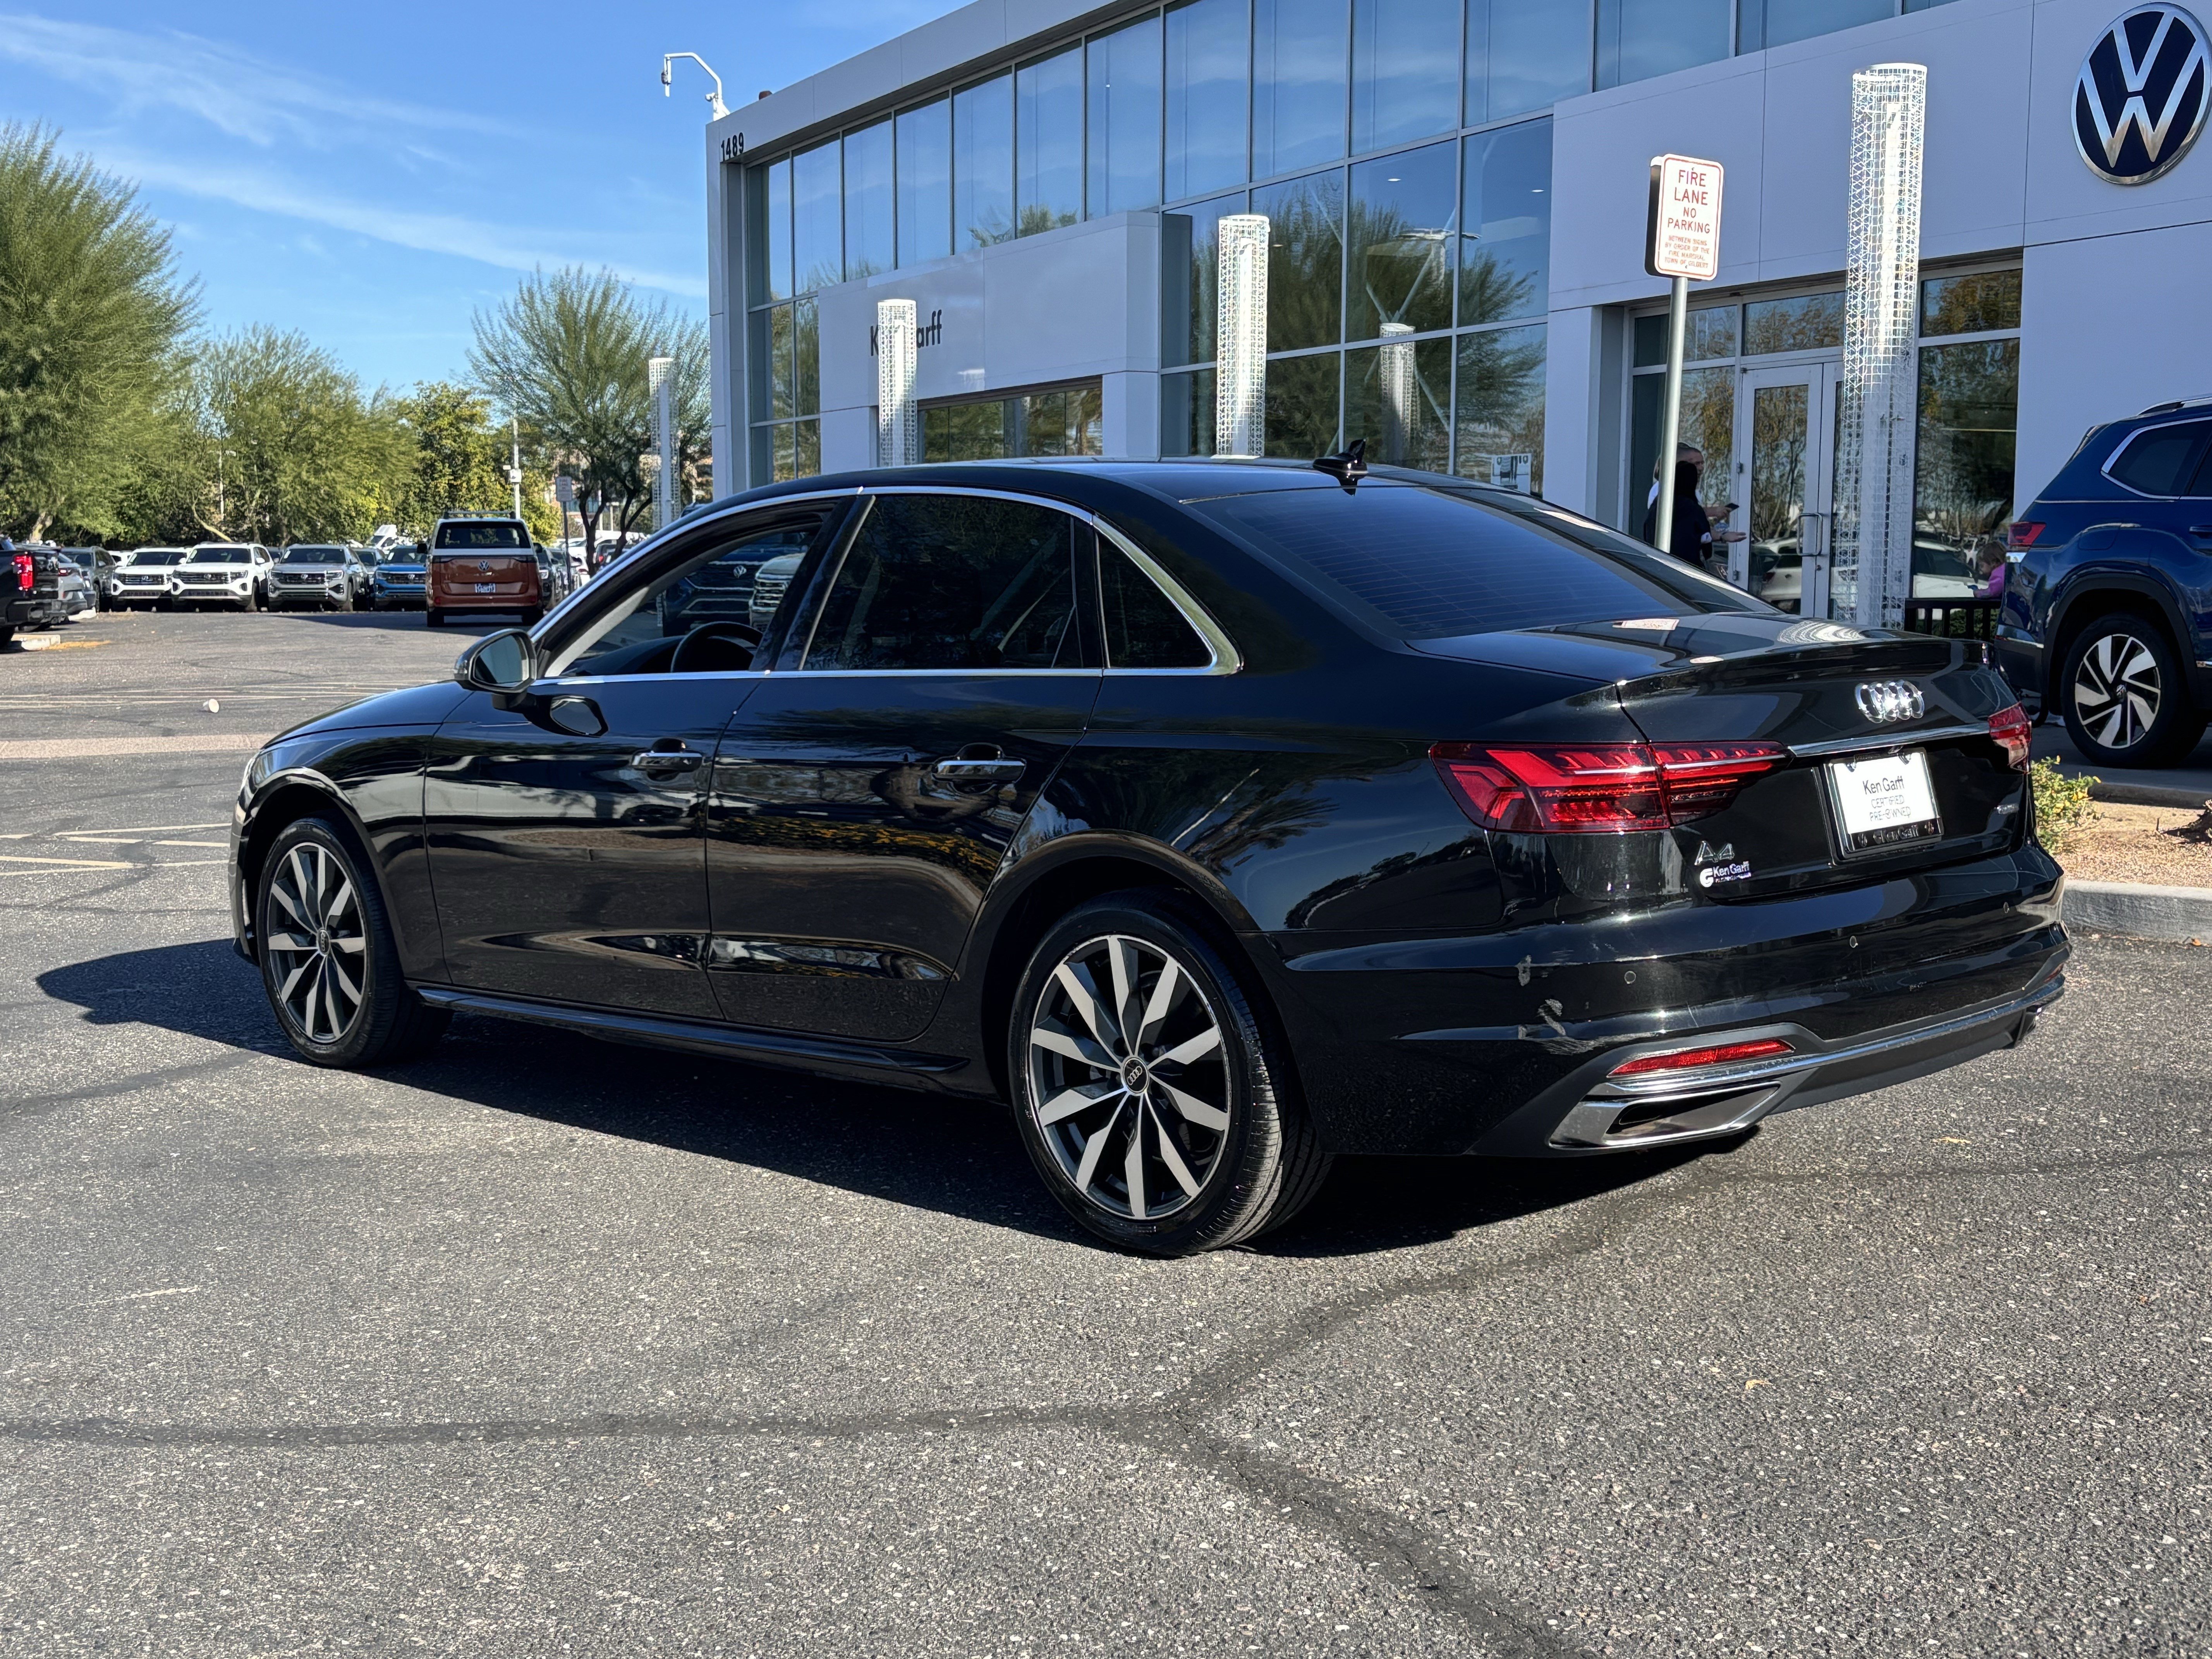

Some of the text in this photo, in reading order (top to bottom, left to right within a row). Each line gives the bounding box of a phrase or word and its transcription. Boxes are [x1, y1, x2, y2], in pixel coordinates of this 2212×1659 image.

[721, 132, 744, 161] 1489
[1678, 169, 1706, 187] FIRE
[1674, 187, 1708, 205] LANE
[1683, 207, 1696, 218] NO
[1668, 218, 1710, 234] PARKING
[916, 309, 942, 348] arff
[1863, 776, 1905, 794] Ken Garff
[1871, 795, 1905, 808] CERTIFIED
[1870, 806, 1911, 821] PRE-OWNED
[1694, 840, 1735, 866] A4
[1713, 866, 1729, 877] Ken
[1729, 861, 1750, 874] Garff
